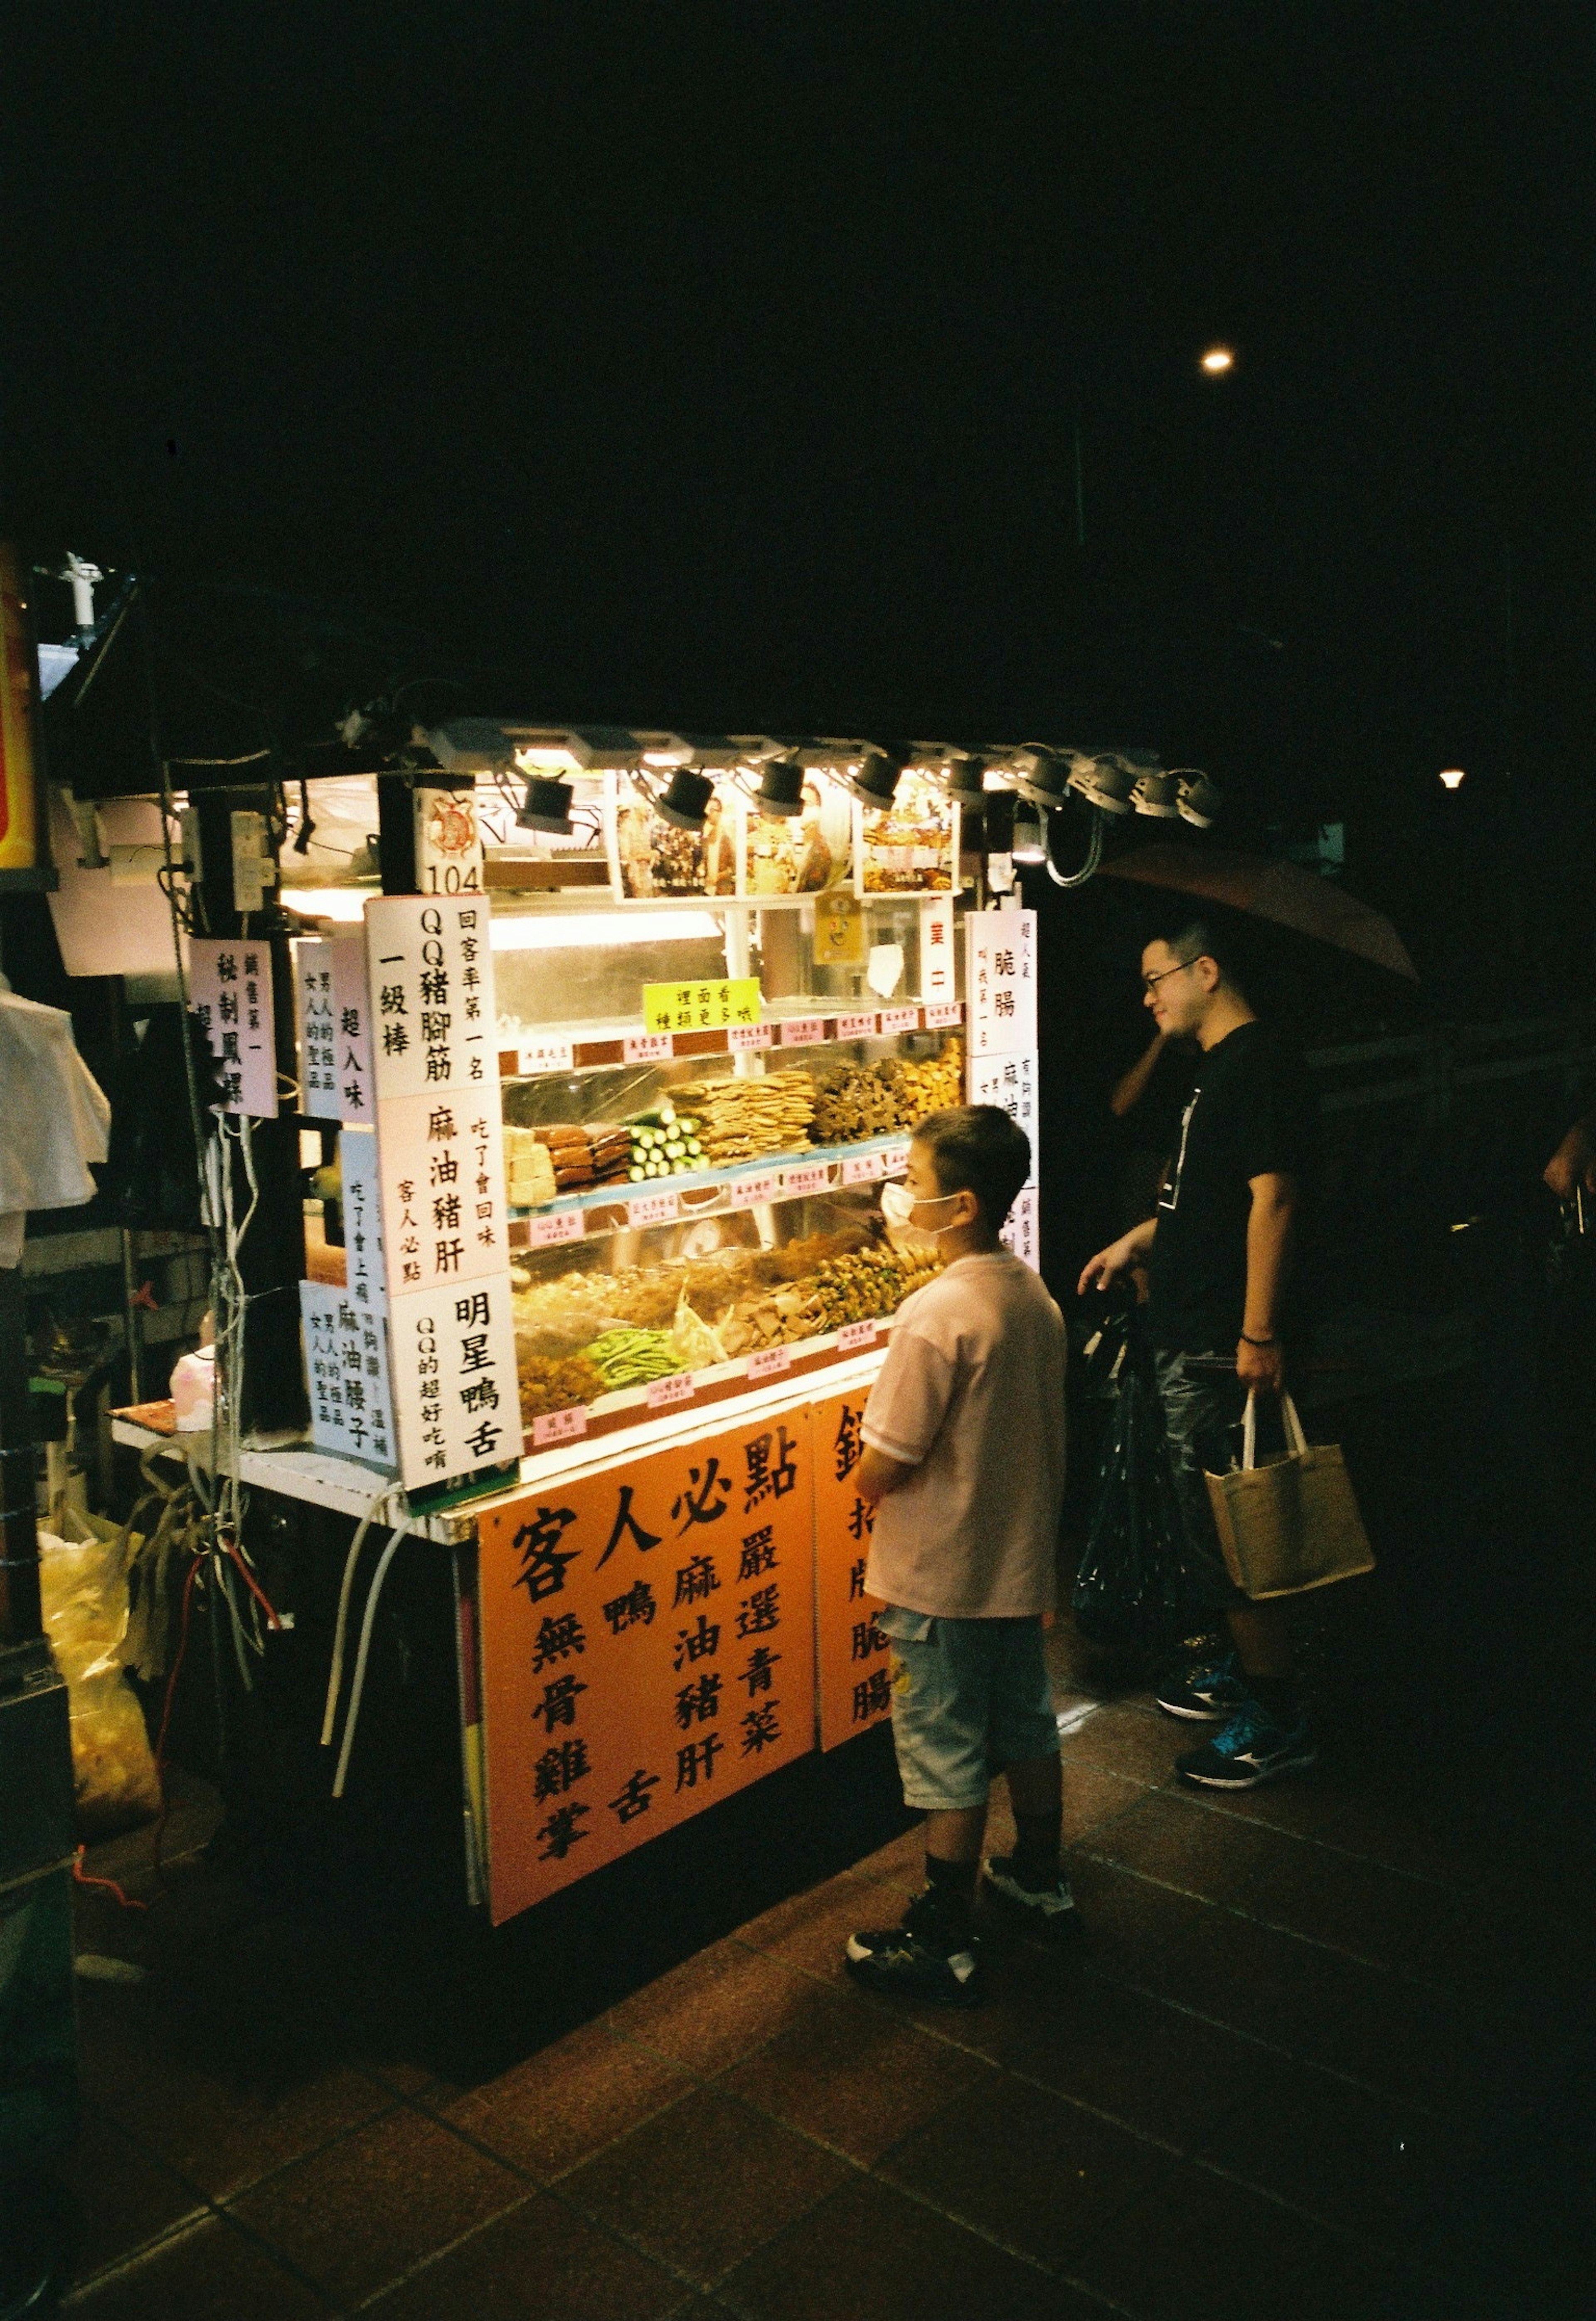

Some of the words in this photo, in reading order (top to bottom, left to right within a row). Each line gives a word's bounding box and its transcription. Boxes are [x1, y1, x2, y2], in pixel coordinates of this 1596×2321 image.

[427, 865, 478, 894] 104
[930, 897, 945, 992] 業中
[341, 1007, 365, 1109] 超入味
[379, 955, 410, 1057] 一級棒
[420, 908, 451, 1082] QQ豬腳筋
[458, 909, 484, 1080] 回客率第一名
[994, 949, 1015, 1018] 脆腸
[397, 1179, 422, 1284] 客人必點
[427, 1105, 465, 1274] 麻油豬肝
[470, 1118, 496, 1248] 吃了會回味
[455, 1292, 503, 1458] 明星鴨舌
[511, 1424, 798, 1604] 客人必點
[602, 1579, 661, 1825] 鴨舌
[671, 1555, 725, 1795] 麻油豬肝
[735, 1524, 782, 1759] 嚴選青菜
[531, 1611, 591, 1862] 無骨雞掌
